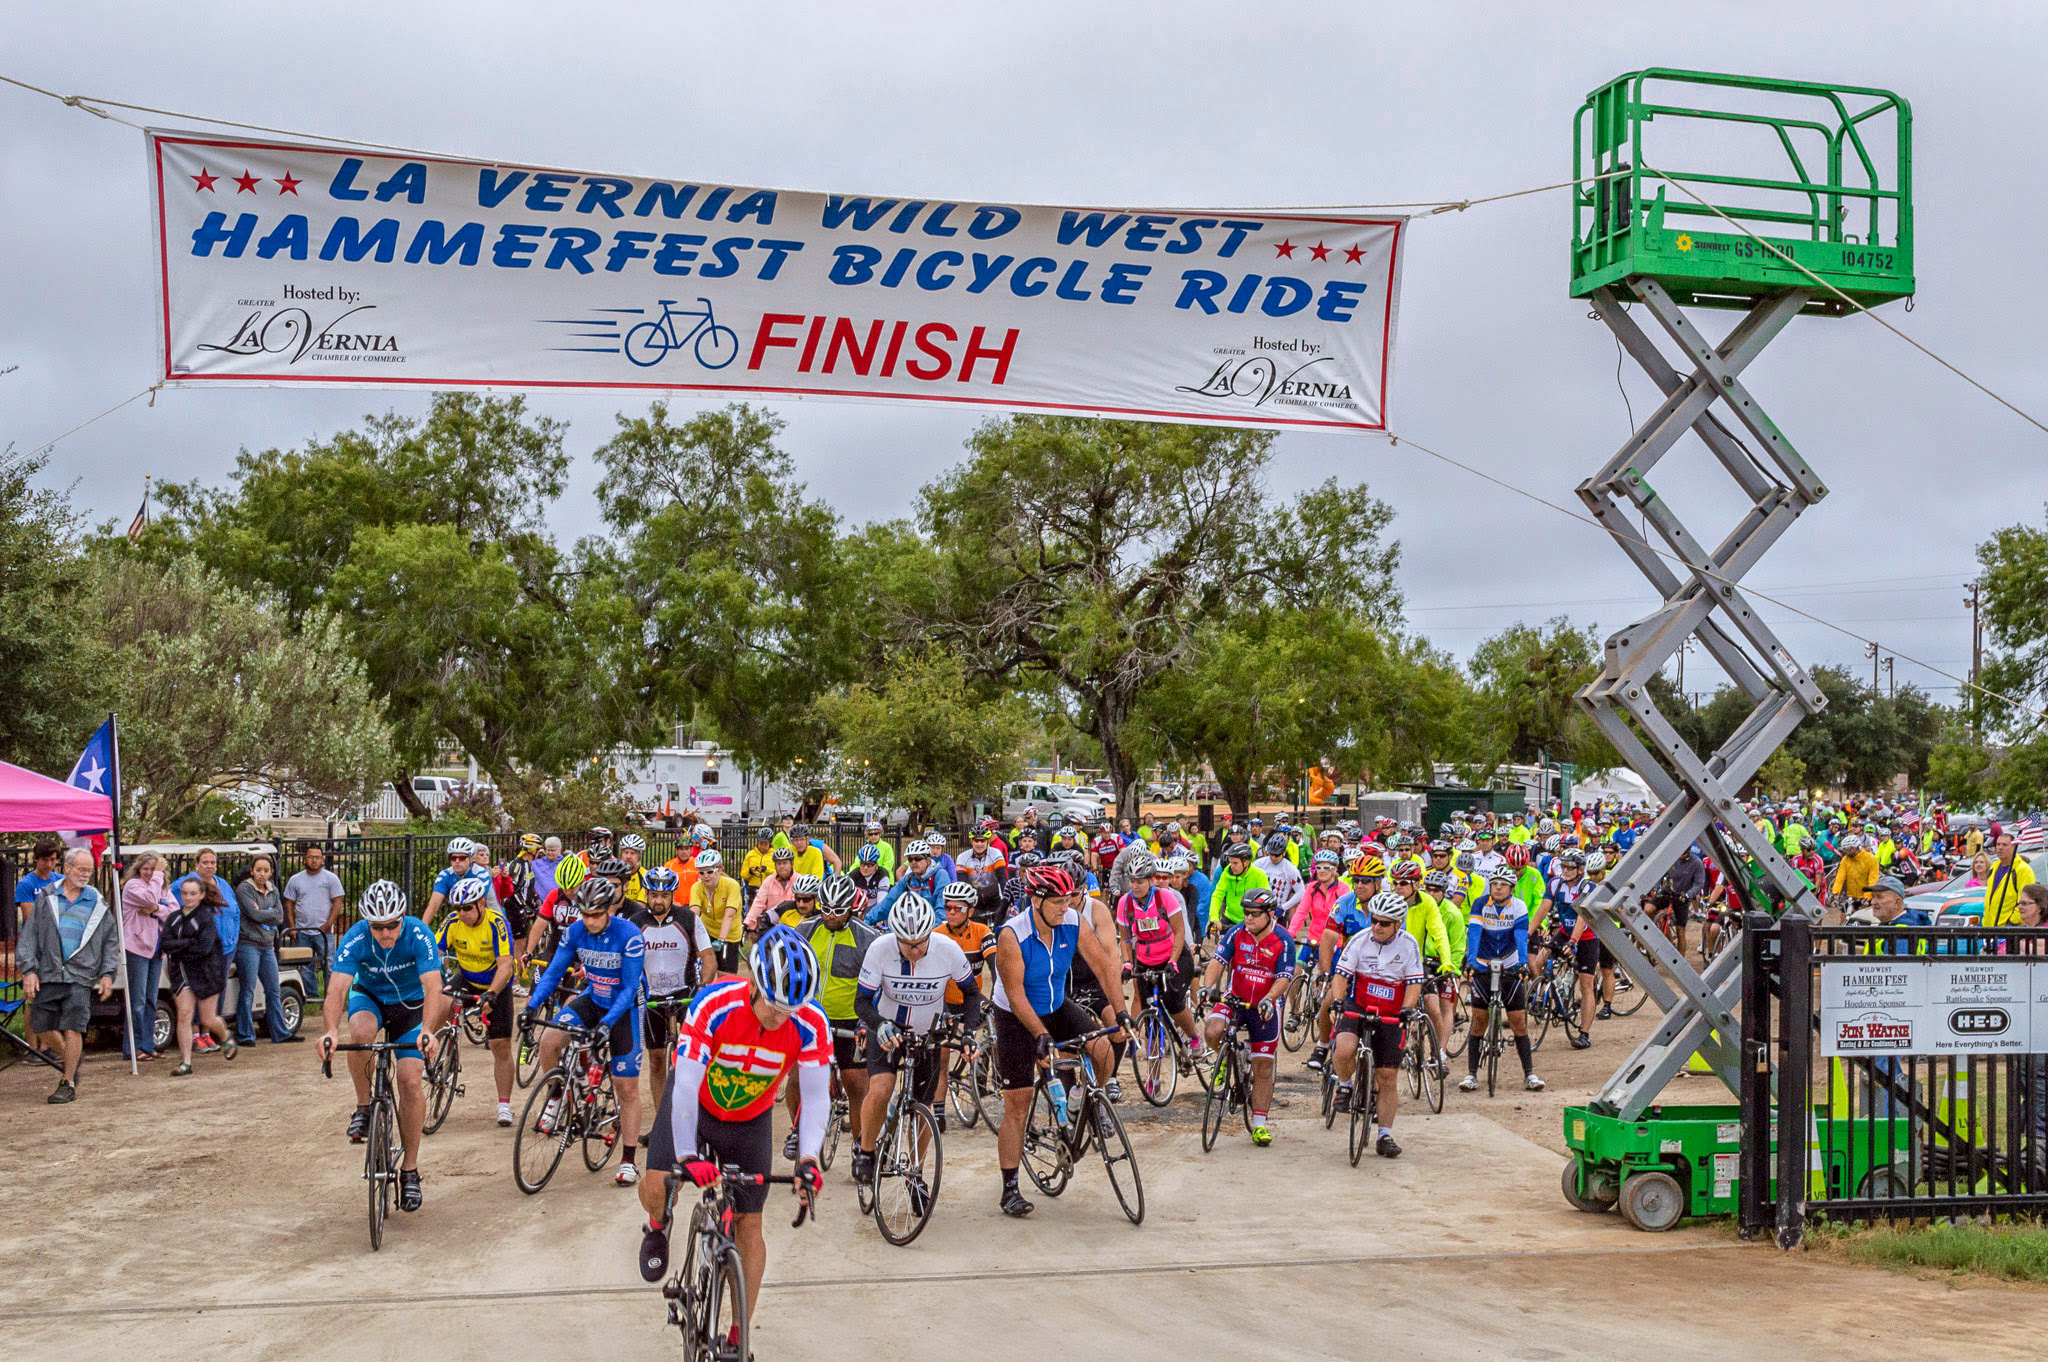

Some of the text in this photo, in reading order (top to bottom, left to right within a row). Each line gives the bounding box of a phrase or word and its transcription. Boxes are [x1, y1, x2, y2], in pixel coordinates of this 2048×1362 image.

[329, 158, 1264, 258] LA VERNIA WILD WEST
[1694, 241, 1731, 251] SUNBELT
[1841, 250, 1894, 270] 104752
[191, 212, 1368, 322] HAMMERFEST BICYCLE RIDE
[284, 285, 360, 304] Hosted by:
[237, 299, 275, 307] GREATER
[747, 314, 1020, 384] FINISH
[1253, 336, 1320, 356] Hosted by:
[1213, 347, 1246, 356] GREATER
[311, 354, 350, 362] CHAMBER
[363, 355, 407, 363] COMMERCE
[1274, 398, 1308, 407] CHAMBER
[1319, 402, 1359, 410] COMMERCE
[645, 941, 678, 951] Alpha
[890, 981, 940, 990] TREK
[893, 993, 937, 1001] TRAVEL
[1372, 986, 1389, 998] USO
[1844, 1000, 1906, 1009] Hoedown Sponsor
[1946, 995, 2012, 1004] Rattlesnake Sponsor
[1954, 1040, 1998, 1049] Everything's
